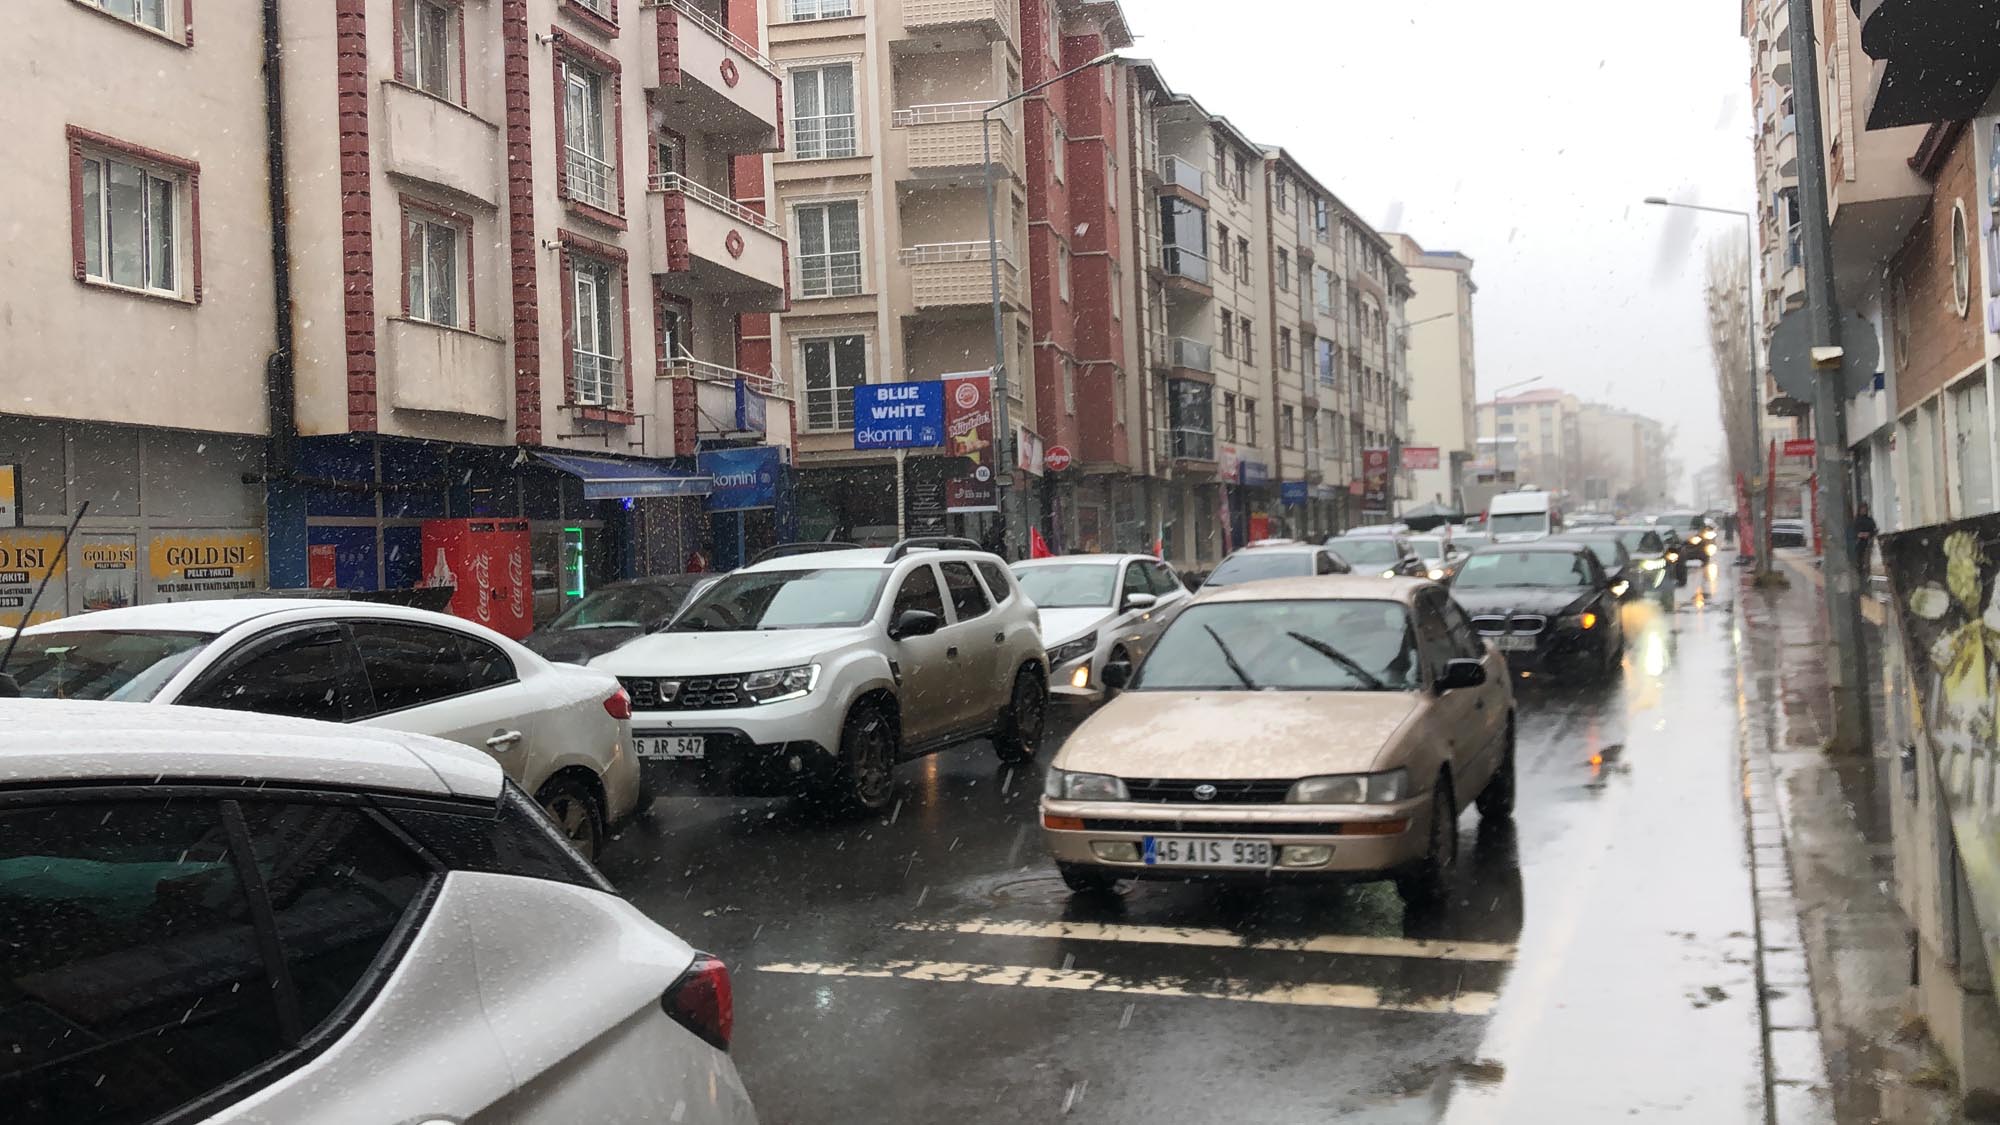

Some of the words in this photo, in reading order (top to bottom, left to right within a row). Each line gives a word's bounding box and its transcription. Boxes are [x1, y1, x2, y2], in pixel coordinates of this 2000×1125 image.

[877, 386, 919, 401] BLUE
[713, 471, 757, 487] komini
[16, 548, 45, 568] ISI
[84, 550, 117, 561] GOLD
[120, 550, 133, 561] ISI
[166, 547, 219, 566] GOLD
[223, 547, 245, 564] ISI
[187, 568, 208, 577] PELET
[209, 568, 231, 577] YAKITI
[654, 740, 668, 753] AR
[678, 739, 701, 753] 547
[1157, 841, 1178, 861] 46
[1187, 842, 1221, 862] AIS
[1232, 843, 1269, 863] 938
